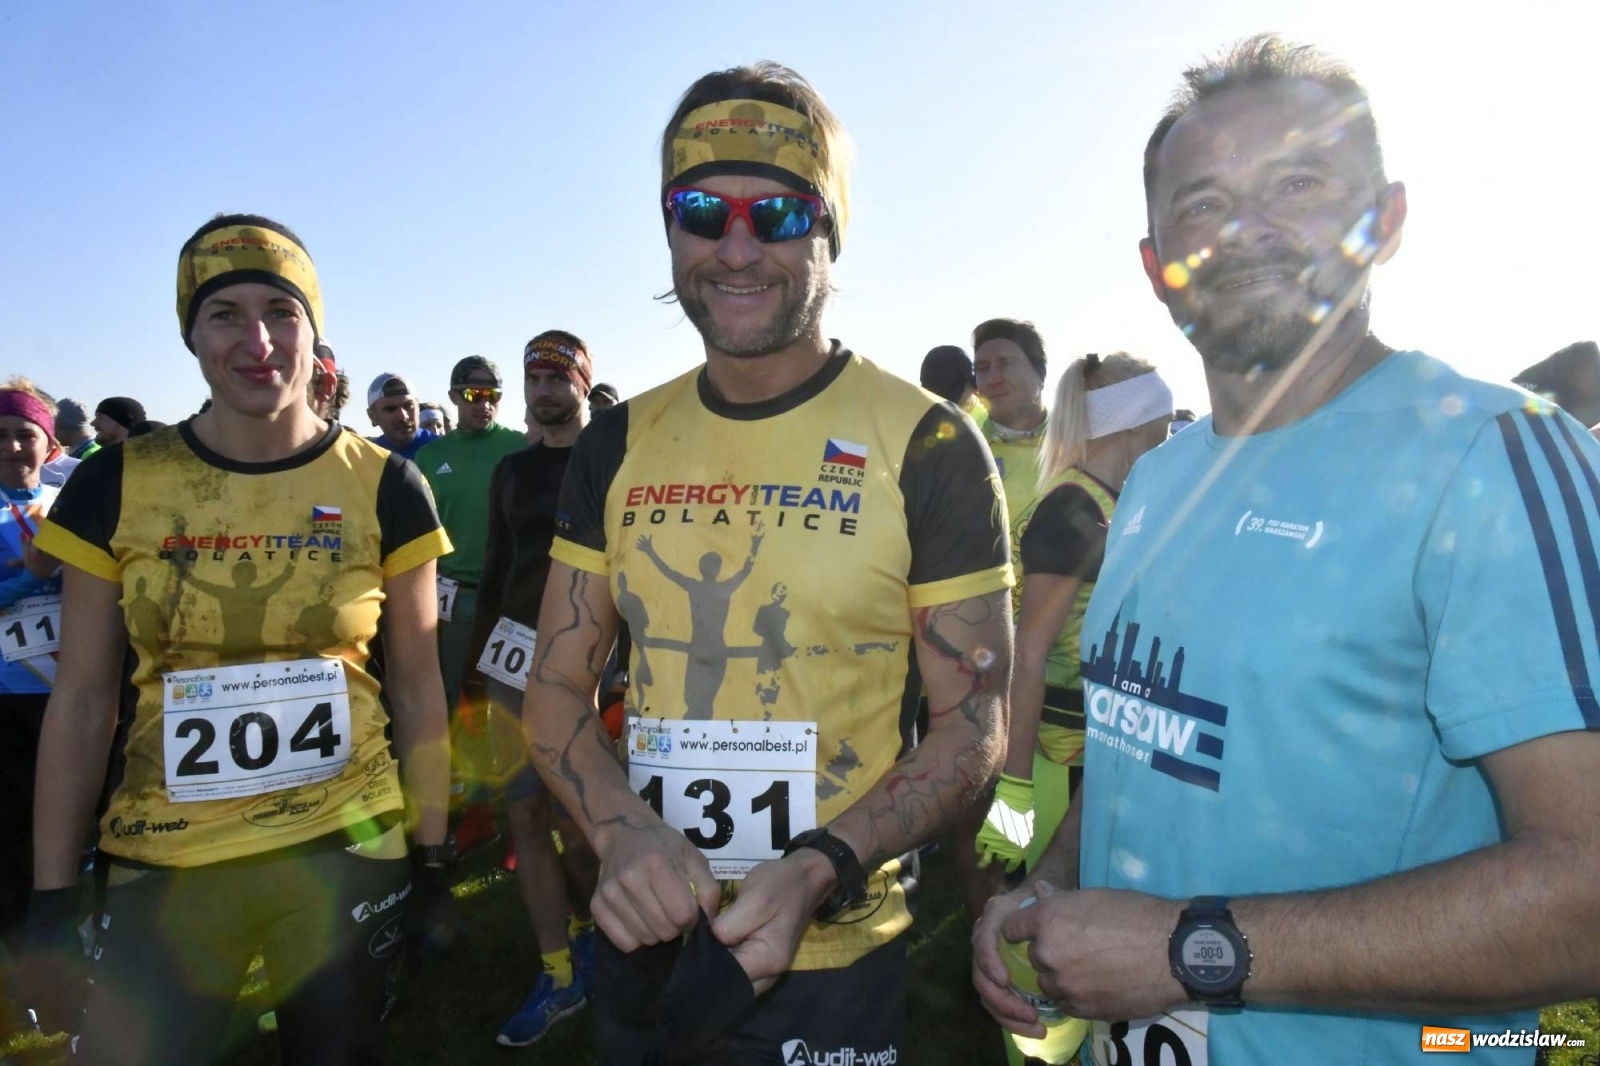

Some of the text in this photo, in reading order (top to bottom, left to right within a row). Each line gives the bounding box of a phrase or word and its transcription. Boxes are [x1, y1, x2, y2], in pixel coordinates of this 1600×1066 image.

[693, 127, 818, 158] BOLATICE
[818, 474, 863, 487] REPUBLIC
[821, 464, 865, 478] CZECH
[625, 484, 751, 507] ENERGY
[759, 484, 861, 514] TEAM
[622, 508, 857, 536] BOLATICE
[163, 535, 264, 549] ENERGY
[273, 535, 342, 550] TEAM
[158, 550, 342, 562] BOLATICE
[491, 639, 528, 678] 10
[221, 670, 338, 692] www.personalbest.pl
[1121, 680, 1141, 695] am
[1144, 687, 1151, 698] a
[175, 702, 341, 777] 204
[680, 739, 808, 755] www.personalbest.pl
[1087, 726, 1150, 763] marathoner
[639, 775, 791, 850] 131
[109, 816, 189, 839] Audit-web
[781, 1038, 898, 1066] Audit-web
